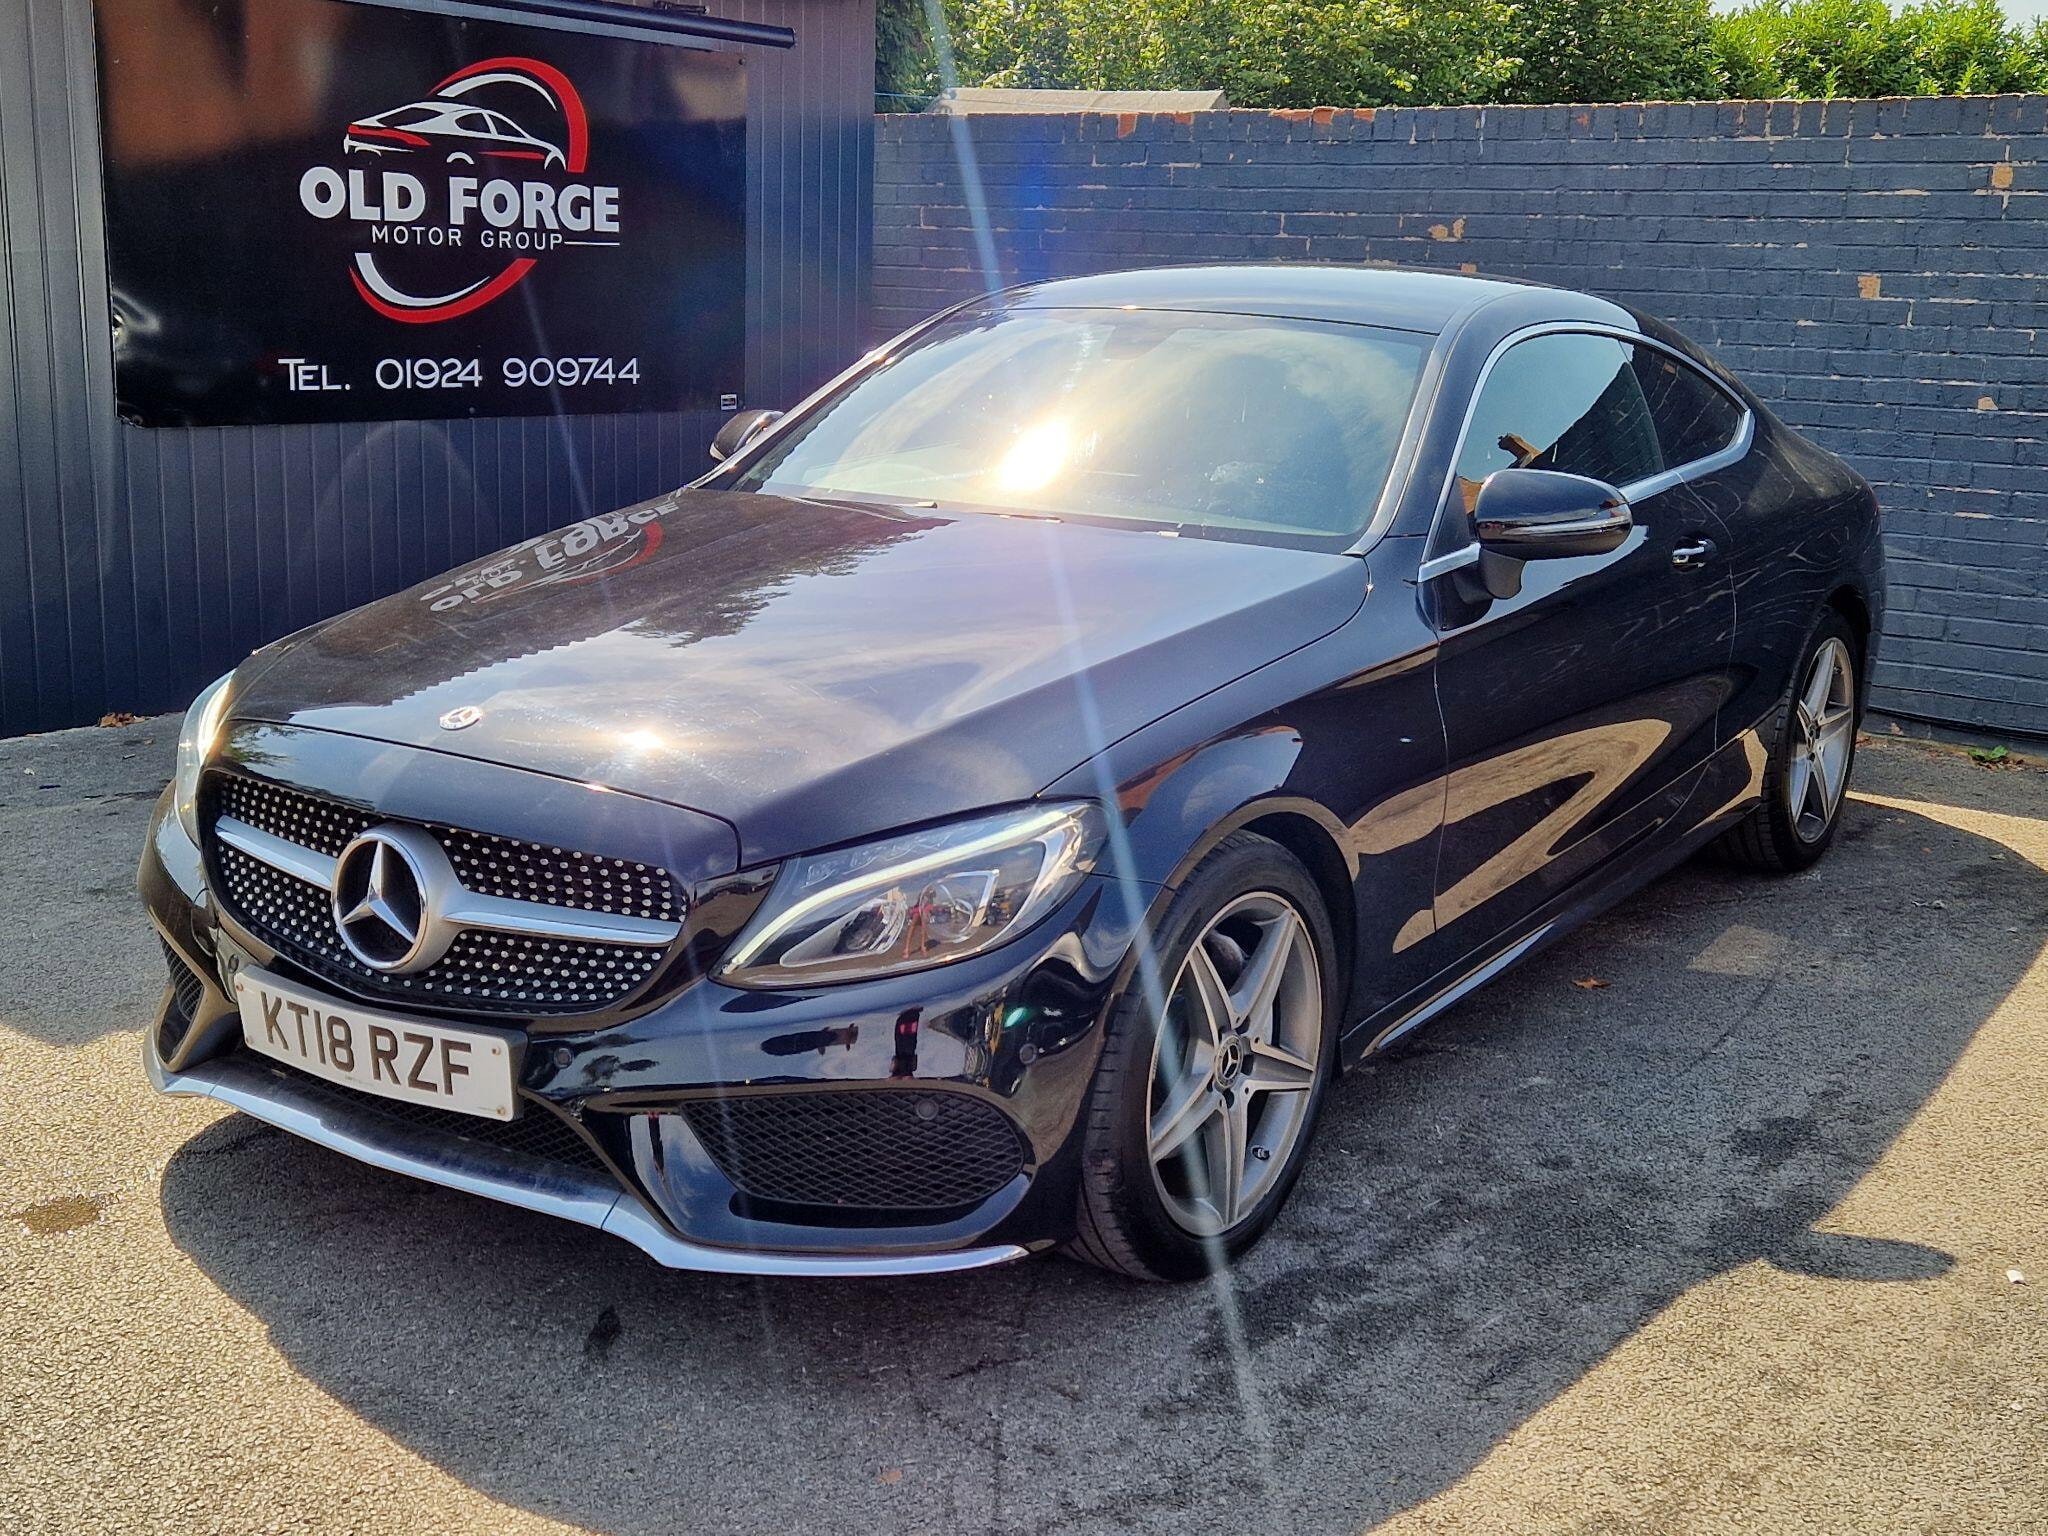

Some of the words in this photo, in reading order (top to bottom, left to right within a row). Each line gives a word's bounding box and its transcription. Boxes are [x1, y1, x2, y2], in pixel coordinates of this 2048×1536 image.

[299, 166, 426, 222] OLD
[448, 176, 620, 232] FORGE
[371, 225, 463, 247] MOTOR
[480, 230, 563, 250] GROUP
[375, 358, 483, 390] 01924
[502, 357, 641, 386] 909744
[260, 991, 355, 1073] KT18
[368, 1024, 472, 1096] RZF
